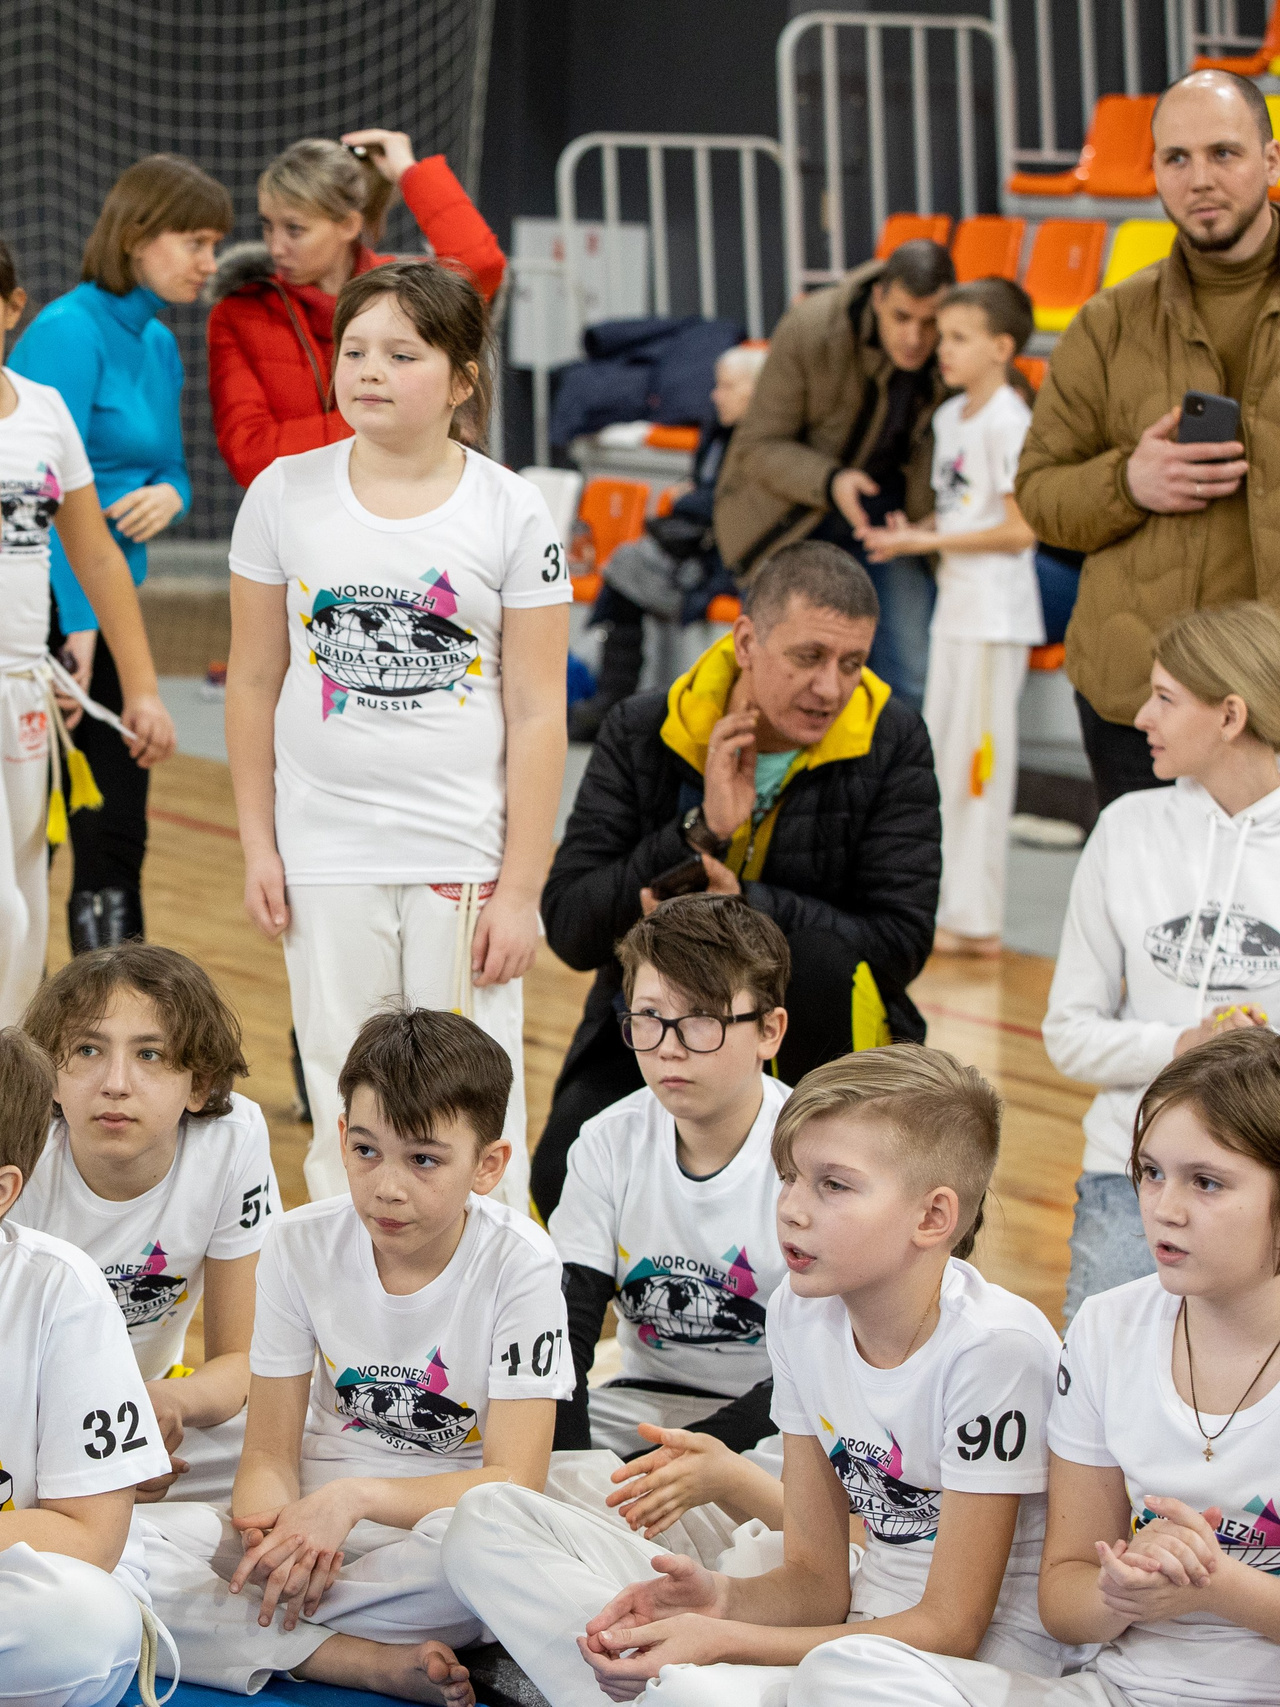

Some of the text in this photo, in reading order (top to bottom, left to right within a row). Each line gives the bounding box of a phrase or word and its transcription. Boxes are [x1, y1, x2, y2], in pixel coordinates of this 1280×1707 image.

[331, 585, 436, 609] VORONEZH
[357, 696, 422, 711] RUSSIA
[100, 1264, 152, 1275] ONEZH
[652, 1256, 738, 1289] VORONEZH
[357, 1365, 431, 1386] VORONEZH
[83, 1401, 148, 1460] 32
[957, 1410, 1026, 1462] 90
